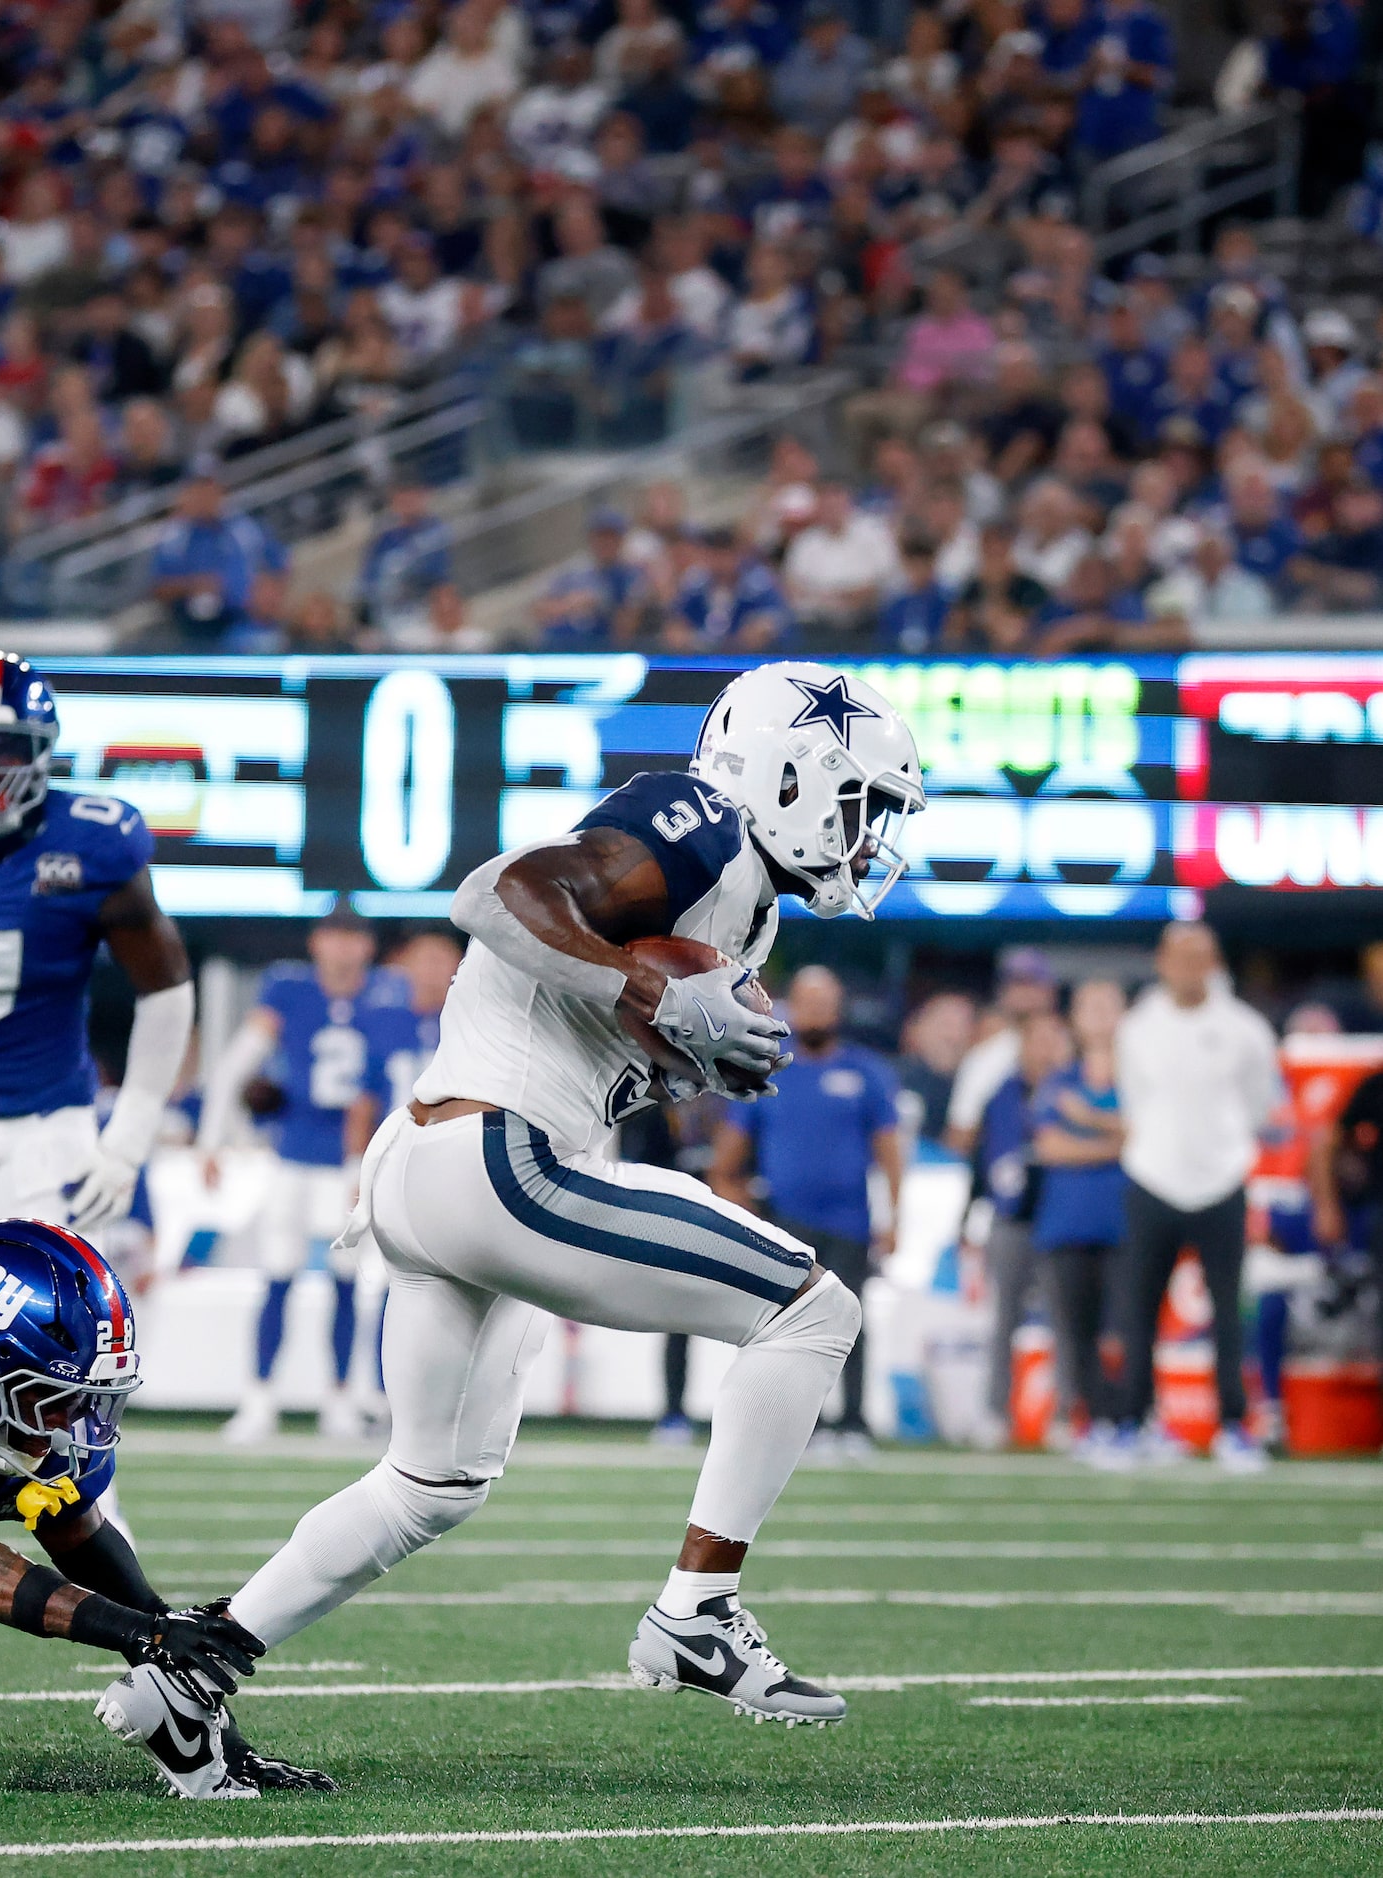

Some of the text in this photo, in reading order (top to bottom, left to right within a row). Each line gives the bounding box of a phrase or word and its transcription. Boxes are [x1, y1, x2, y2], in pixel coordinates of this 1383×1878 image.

[652, 800, 702, 843] 3
[310, 1027, 364, 1109] 2
[49, 1366, 81, 1380] OAKLEY
